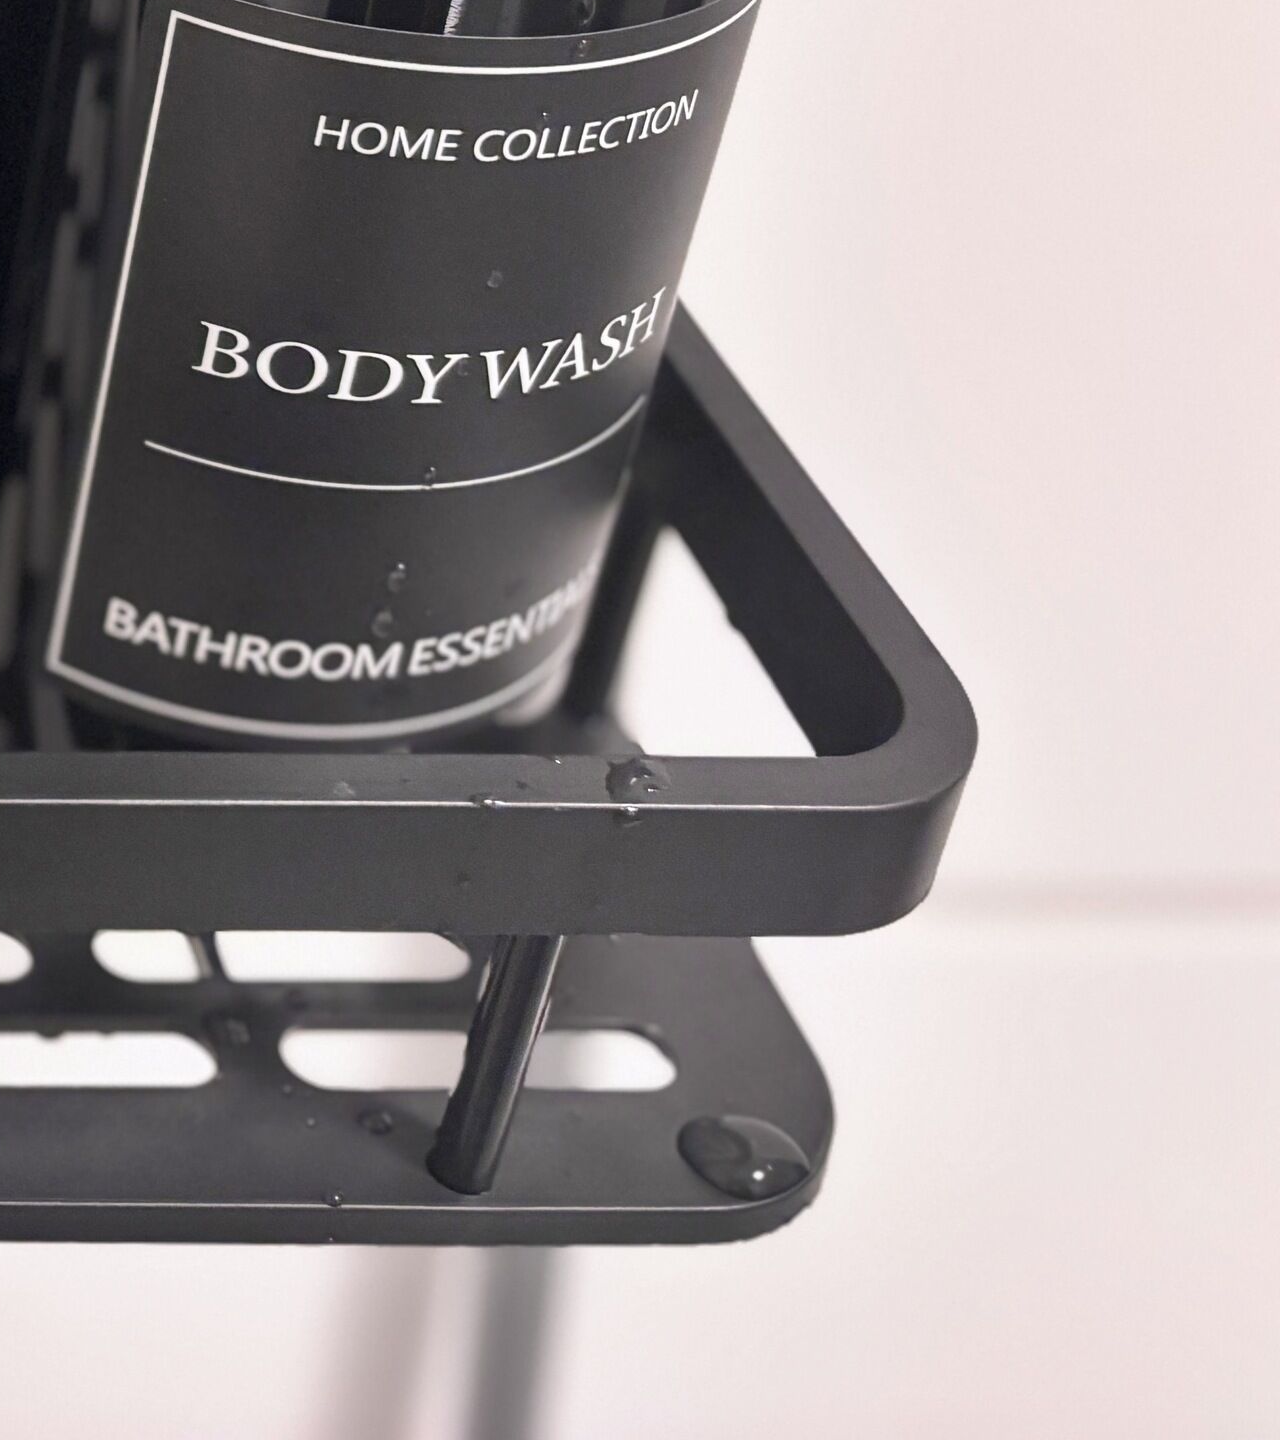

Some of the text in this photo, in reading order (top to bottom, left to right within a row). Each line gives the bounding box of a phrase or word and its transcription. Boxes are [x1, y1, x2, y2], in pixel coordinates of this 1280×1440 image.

[312, 88, 700, 163] HOME COLLECTION
[191, 285, 668, 405] BODY WASH
[103, 596, 405, 681] BATHROOM
